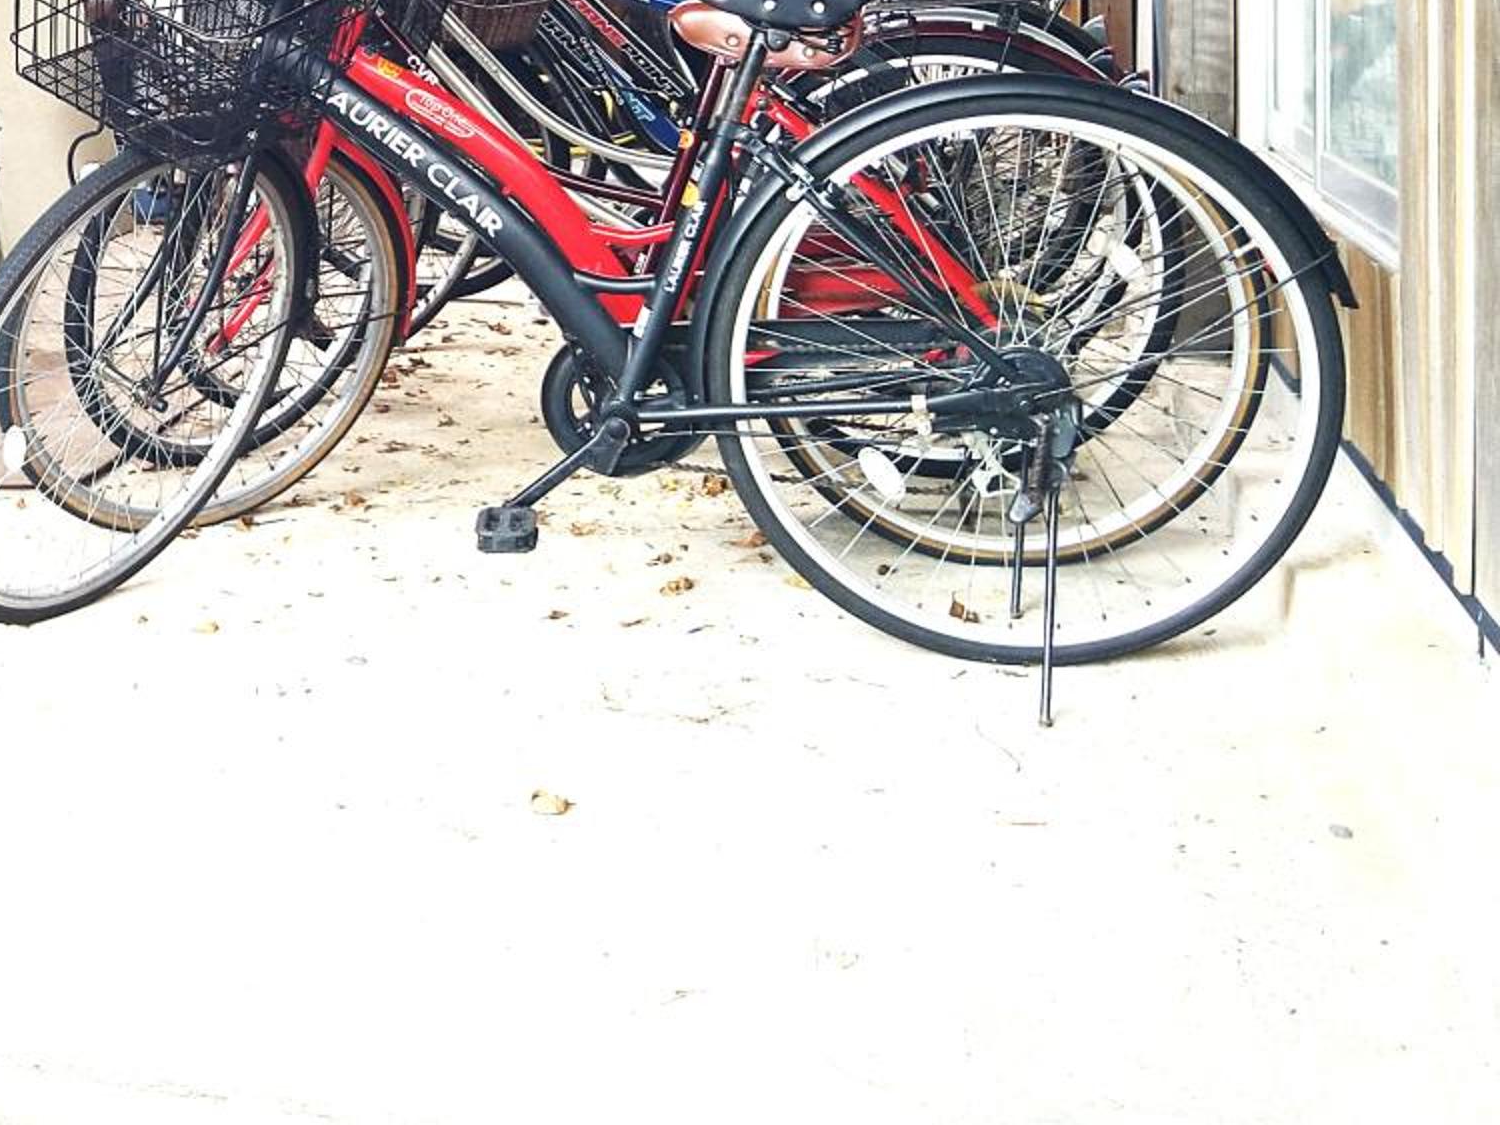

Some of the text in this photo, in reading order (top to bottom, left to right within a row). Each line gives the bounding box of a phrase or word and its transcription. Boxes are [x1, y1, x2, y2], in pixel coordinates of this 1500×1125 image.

[621, 41, 684, 98] POINT
[311, 77, 428, 169] LAURIER
[427, 161, 504, 239] CLAIR
